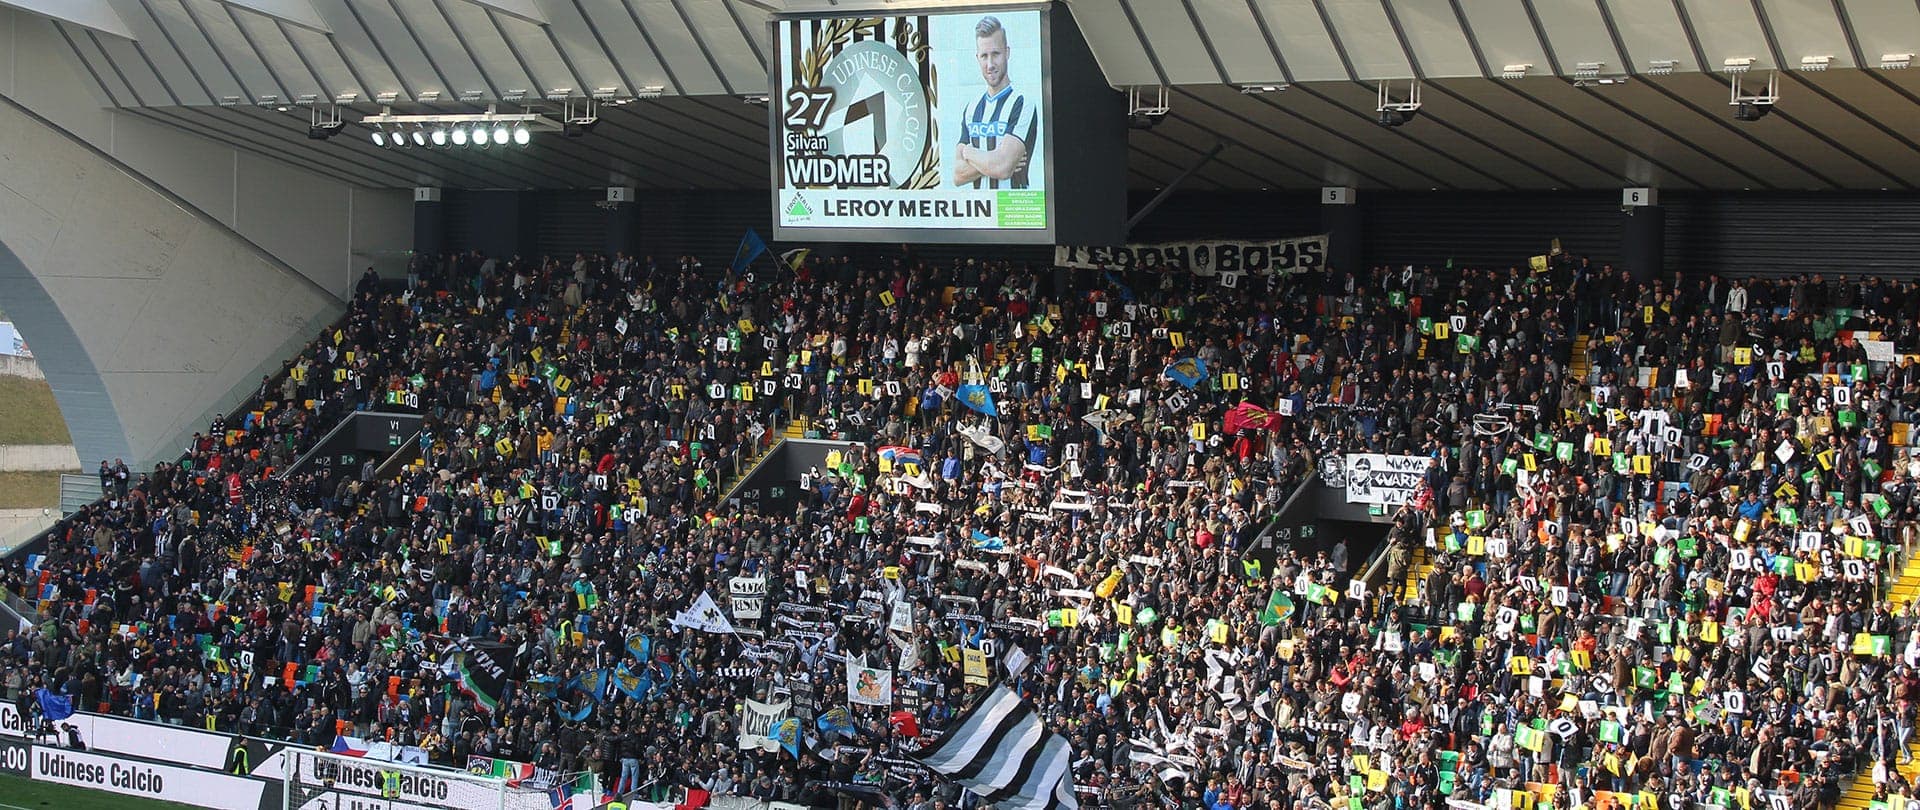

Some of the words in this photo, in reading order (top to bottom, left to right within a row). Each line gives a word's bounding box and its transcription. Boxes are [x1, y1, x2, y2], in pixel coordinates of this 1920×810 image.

[786, 91, 833, 126] 27
[832, 51, 898, 85] UDINESE
[897, 73, 920, 152] CALCIO
[787, 133, 828, 150] Silvan
[788, 158, 888, 184] WIDMER
[1329, 190, 1337, 201] 5
[1631, 191, 1640, 202] 6
[823, 199, 891, 217] LEROY
[899, 199, 992, 218] MERLIN
[1214, 241, 1323, 274] BOYS
[1386, 457, 1424, 471] NUOVA
[1374, 472, 1418, 488] GUARD
[39, 751, 105, 785] Udinese
[110, 763, 163, 796] Calcio
